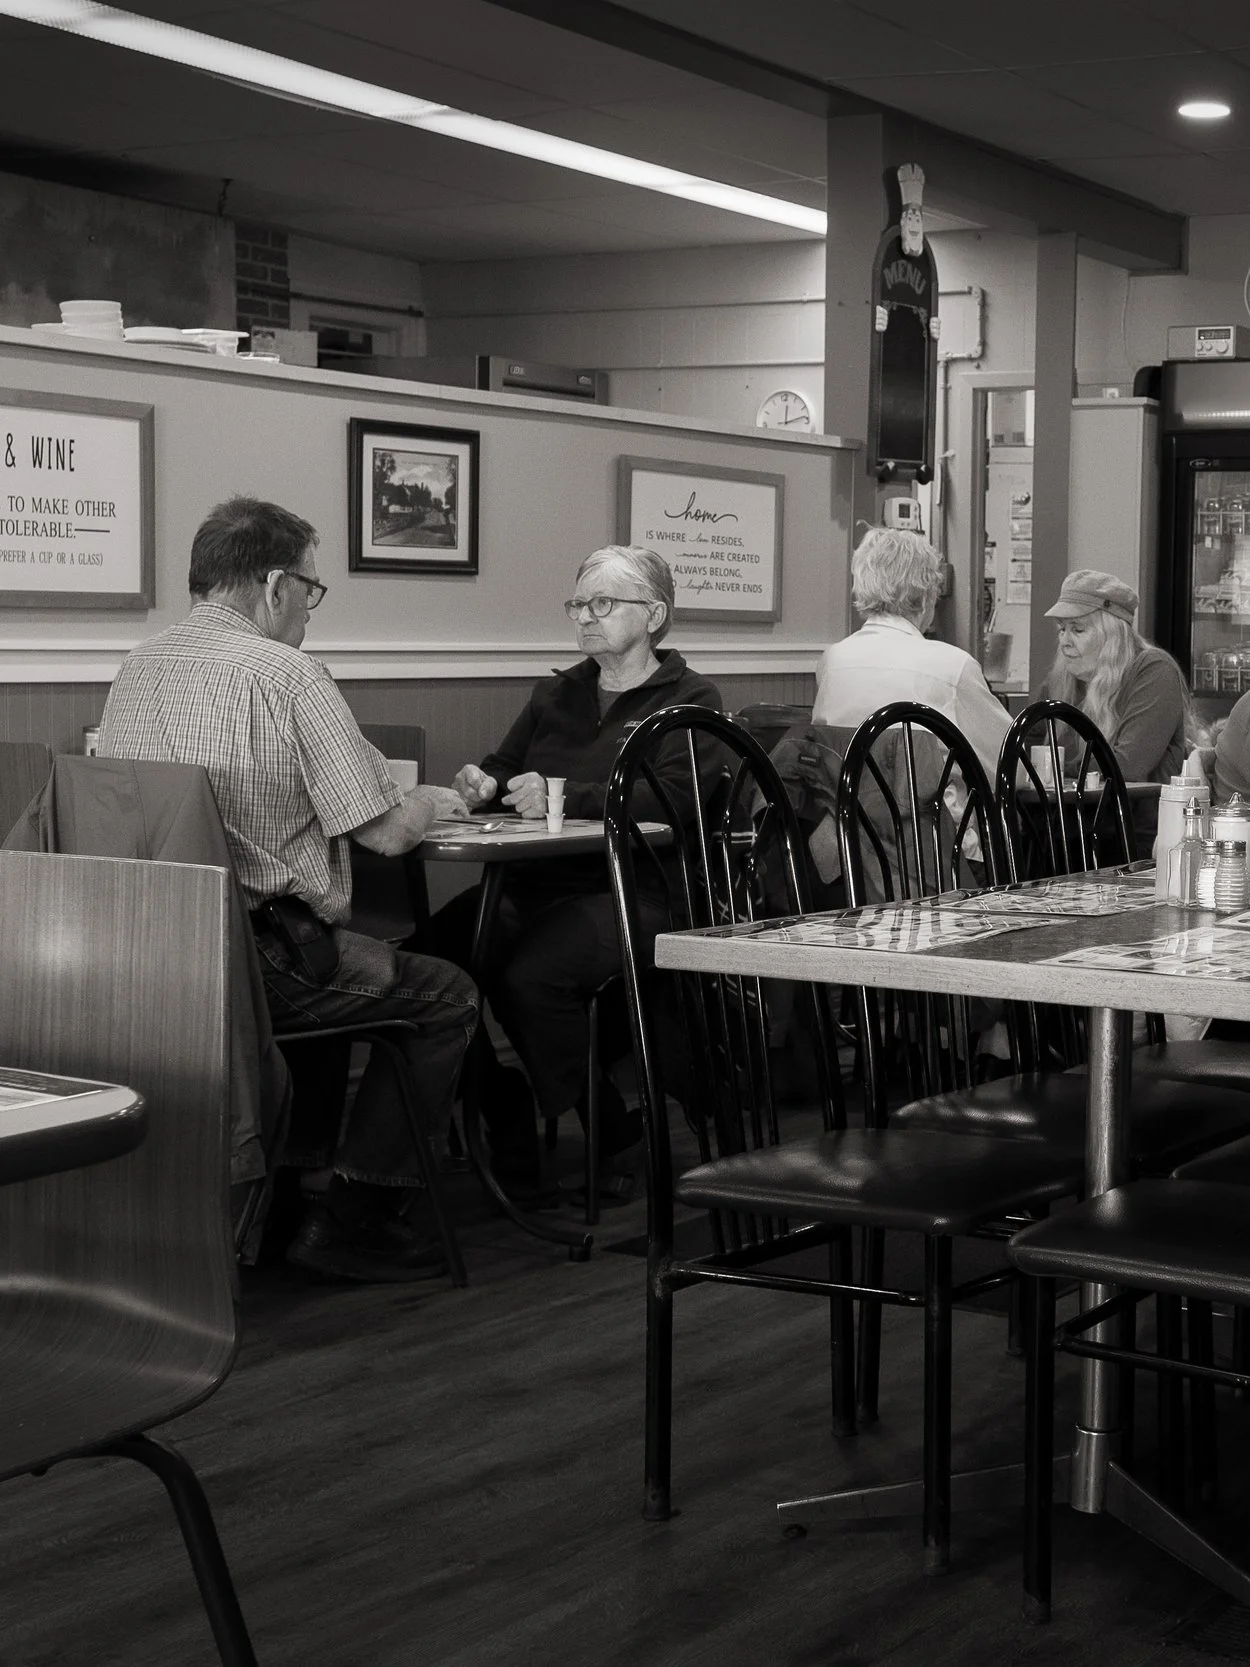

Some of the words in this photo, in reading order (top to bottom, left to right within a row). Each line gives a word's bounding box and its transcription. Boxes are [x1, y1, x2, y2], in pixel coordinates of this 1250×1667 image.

[883, 259, 926, 295] MENU
[4, 432, 16, 468] &
[31, 435, 75, 472] WINE
[7, 495, 25, 513] TO
[31, 496, 69, 515] MAKE
[75, 499, 117, 518] OTHER
[664, 491, 739, 523] home
[645, 530, 654, 539] IS
[656, 531, 686, 542] WHERE
[711, 535, 745, 547] RESIDES,
[30, 552, 35, 564] A
[39, 552, 53, 564] CUP
[56, 552, 67, 564] OR
[70, 553, 75, 565] A
[78, 553, 104, 567] GLASS)
[709, 552, 725, 561] ARE
[727, 552, 760, 564] CREATED
[674, 564, 708, 576] ALWAYS
[709, 566, 743, 579] BELONG,
[715, 582, 740, 593] NEVER
[742, 583, 763, 594] ENDS
